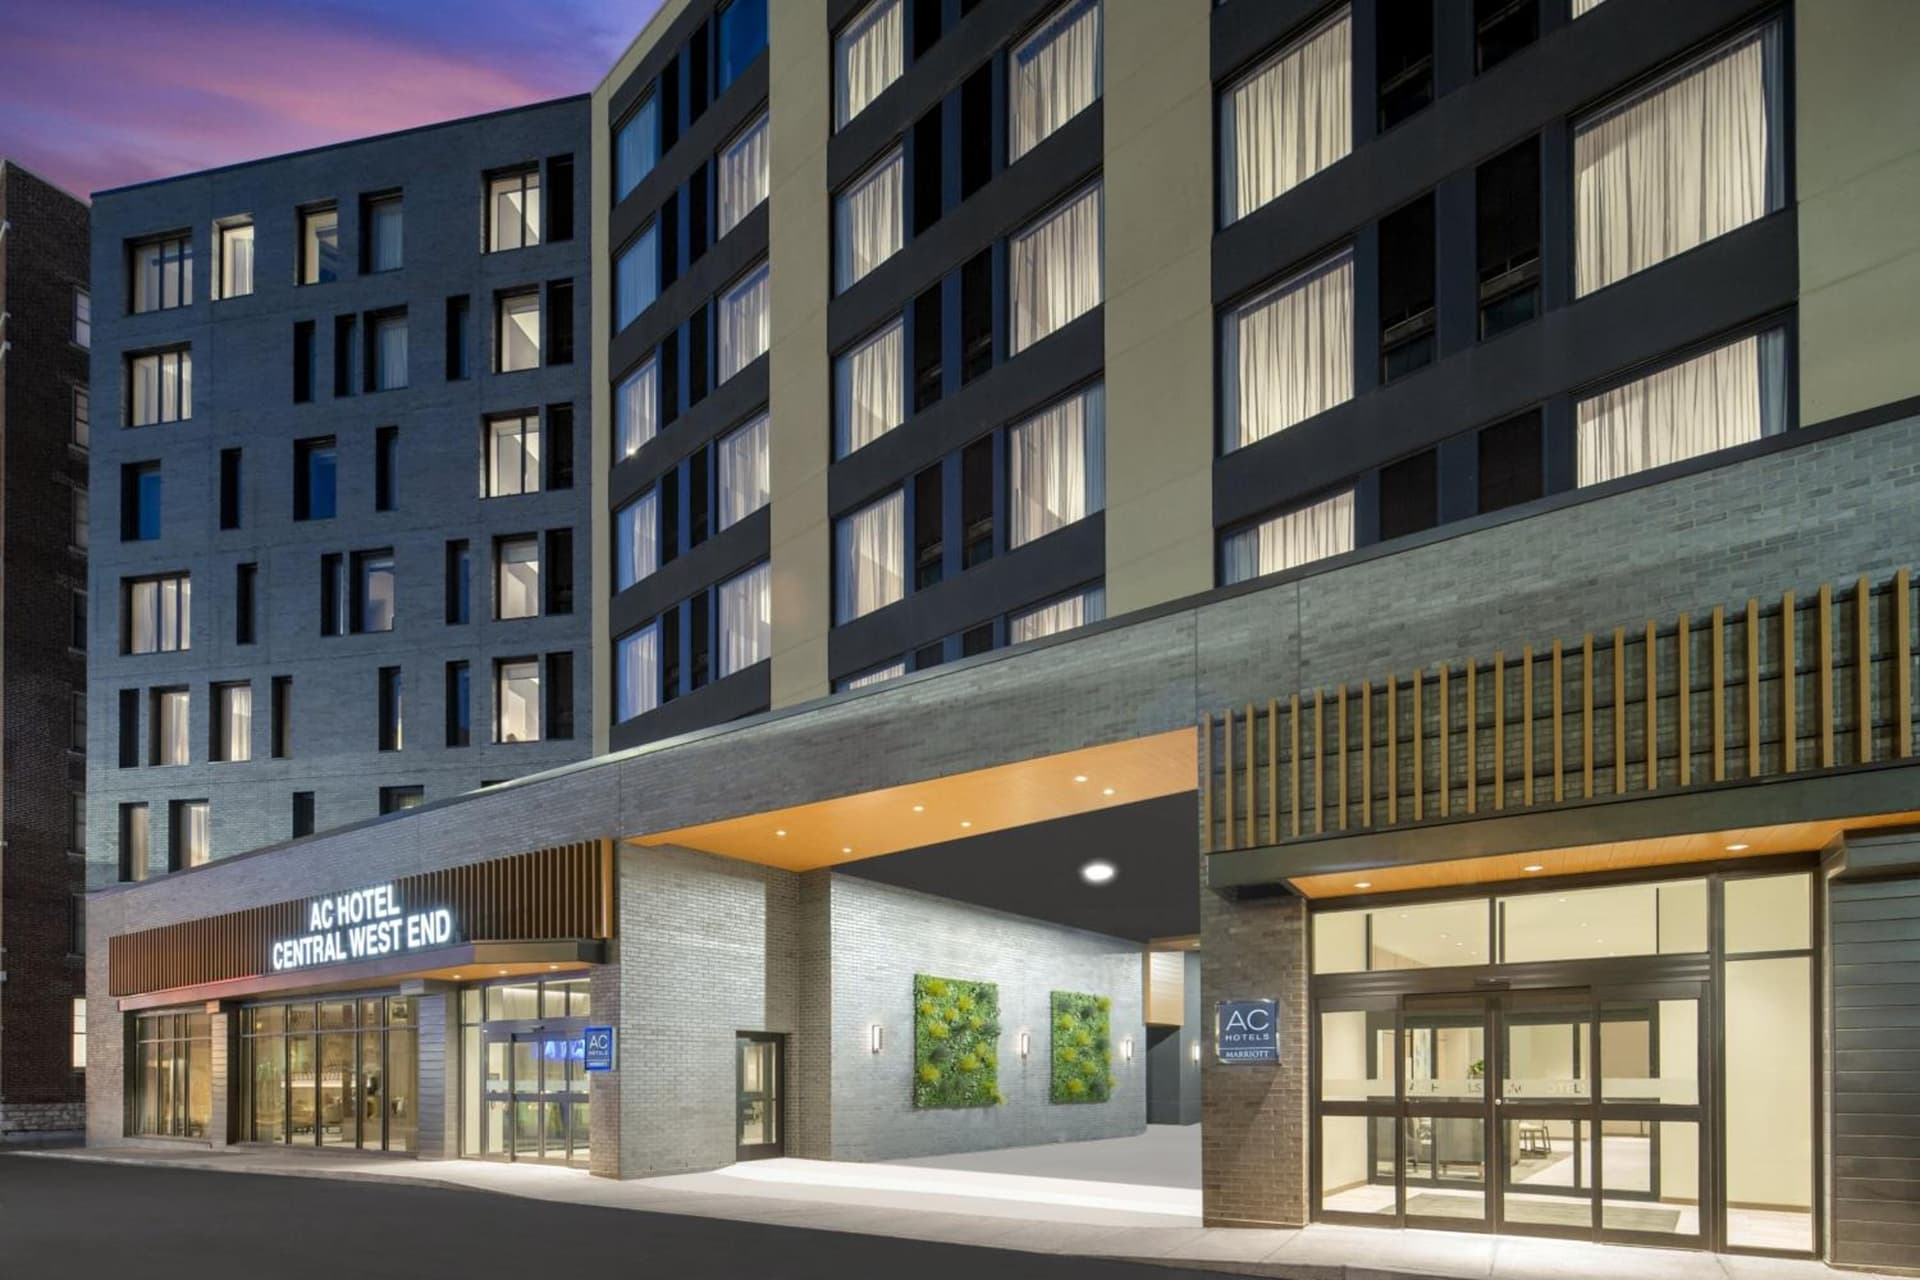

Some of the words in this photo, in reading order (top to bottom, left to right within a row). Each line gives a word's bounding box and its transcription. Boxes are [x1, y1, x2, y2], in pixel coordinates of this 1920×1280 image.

[310, 901, 334, 931] AC
[337, 884, 400, 925] HOTEL
[272, 931, 347, 970] CENTRAL
[349, 918, 403, 957] WEST
[407, 909, 451, 948] END
[1225, 1008, 1269, 1031] AC
[589, 1034, 608, 1049] AC
[1225, 1033, 1270, 1041] HOTELS
[1225, 1050, 1270, 1058] MARRIOTT
